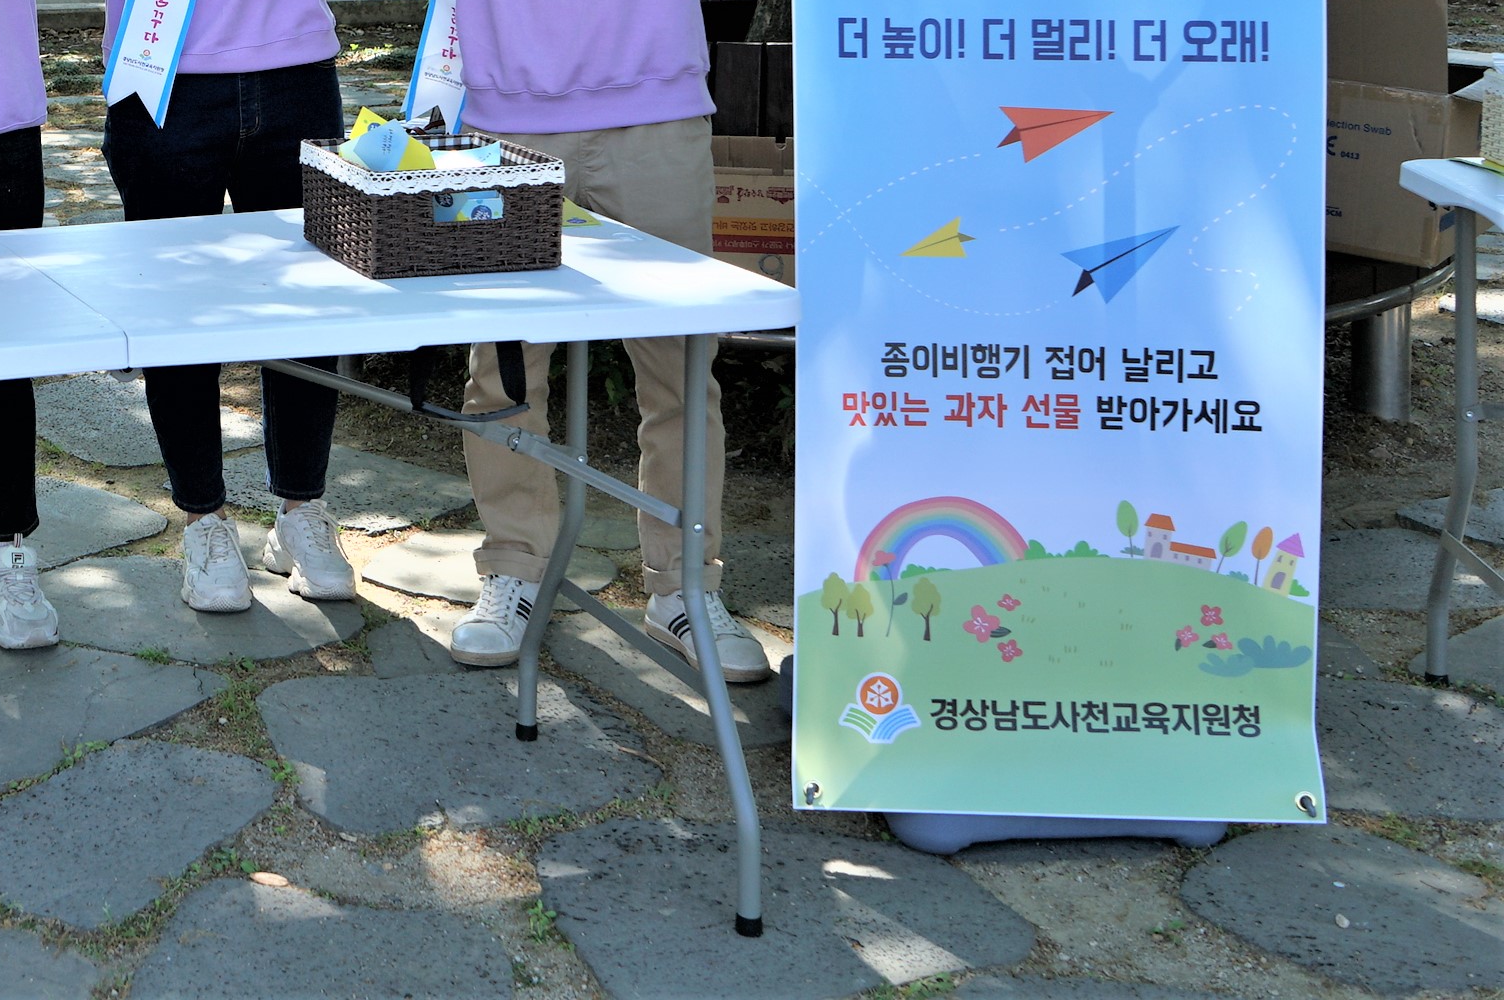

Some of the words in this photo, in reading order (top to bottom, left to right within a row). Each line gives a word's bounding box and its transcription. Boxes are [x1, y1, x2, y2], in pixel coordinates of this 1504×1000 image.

[838, 17, 868, 59] 더
[882, 17, 966, 60] 높이!
[982, 18, 1015, 60] 더
[1031, 18, 1116, 61] 멀리!
[1133, 19, 1166, 62] 더
[1182, 19, 1270, 63] 오래!
[1363, 123, 1392, 136] Swab
[880, 341, 1030, 380] 종이비행기
[1044, 346, 1106, 381] 접어
[1121, 347, 1219, 383] 날리고
[841, 391, 930, 428] 맛있는
[943, 392, 1007, 428] 과자
[1021, 393, 1082, 430] 선물
[1096, 396, 1263, 434] 받아가세요
[929, 698, 1262, 738] 경상남도사천교육지원청
